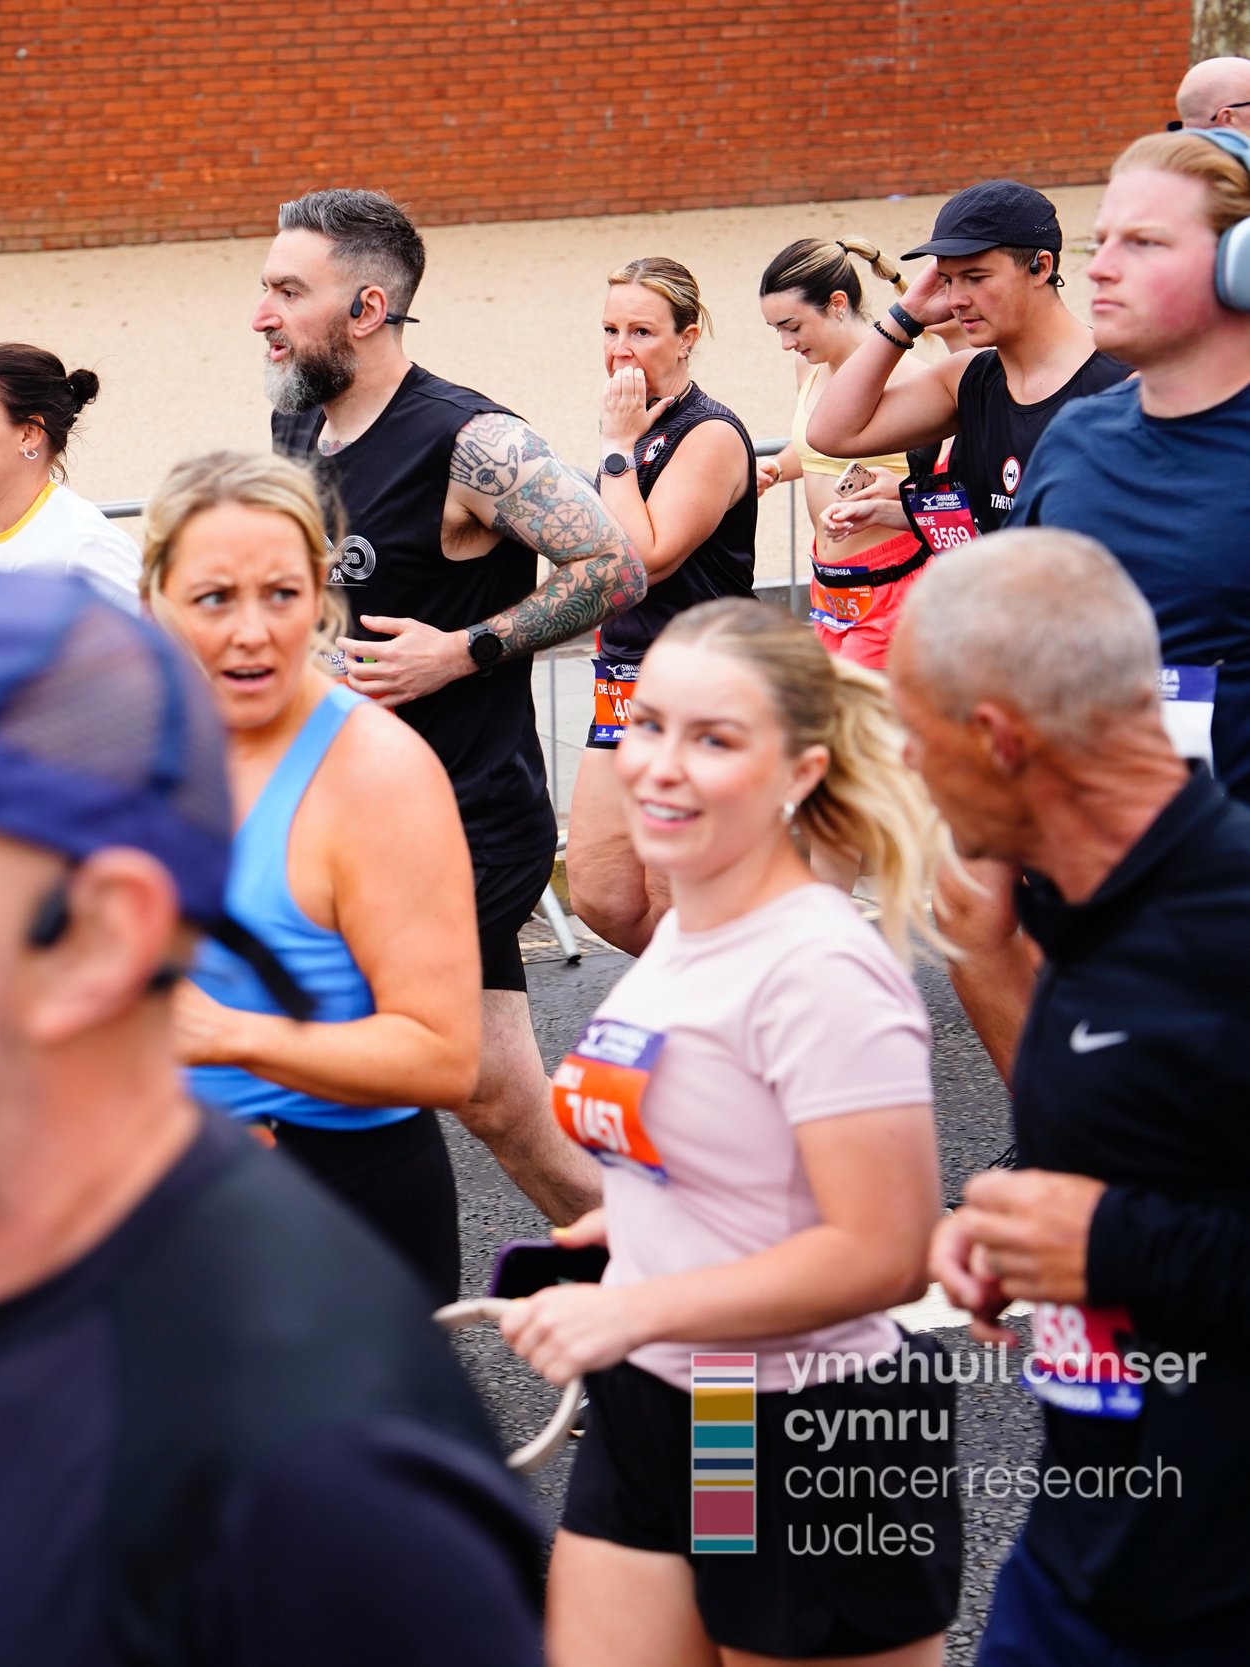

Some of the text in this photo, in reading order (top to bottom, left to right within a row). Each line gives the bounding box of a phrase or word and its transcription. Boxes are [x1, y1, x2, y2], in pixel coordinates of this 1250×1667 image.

[936, 493, 960, 502] SWANSEA
[915, 516, 937, 527] NIEVE
[929, 526, 972, 550] 3569
[597, 683, 622, 696] DELLA
